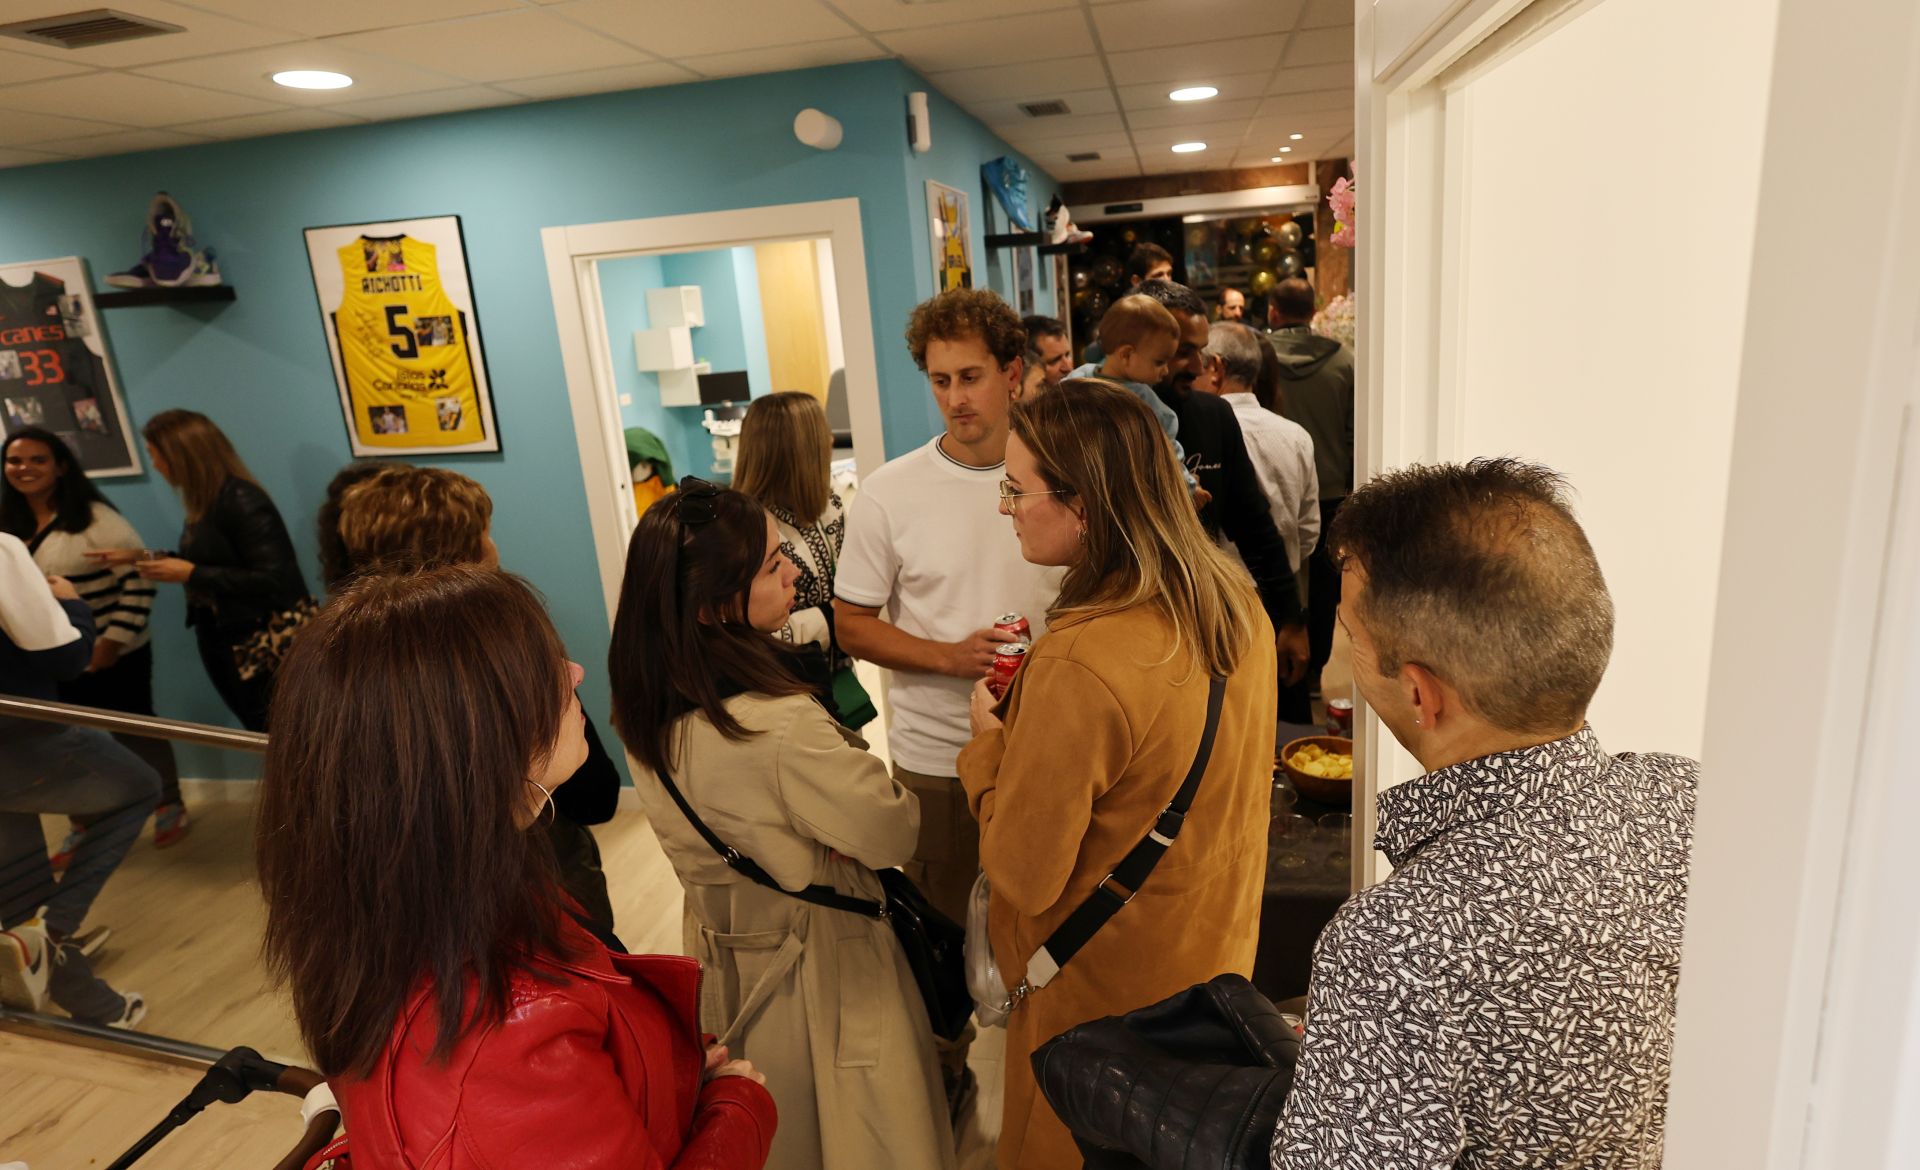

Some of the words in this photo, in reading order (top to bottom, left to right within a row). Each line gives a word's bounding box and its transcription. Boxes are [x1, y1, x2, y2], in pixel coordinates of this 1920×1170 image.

[362, 275, 422, 293] RICHOTTI
[385, 305, 419, 358] 5
[18, 350, 65, 385] 33
